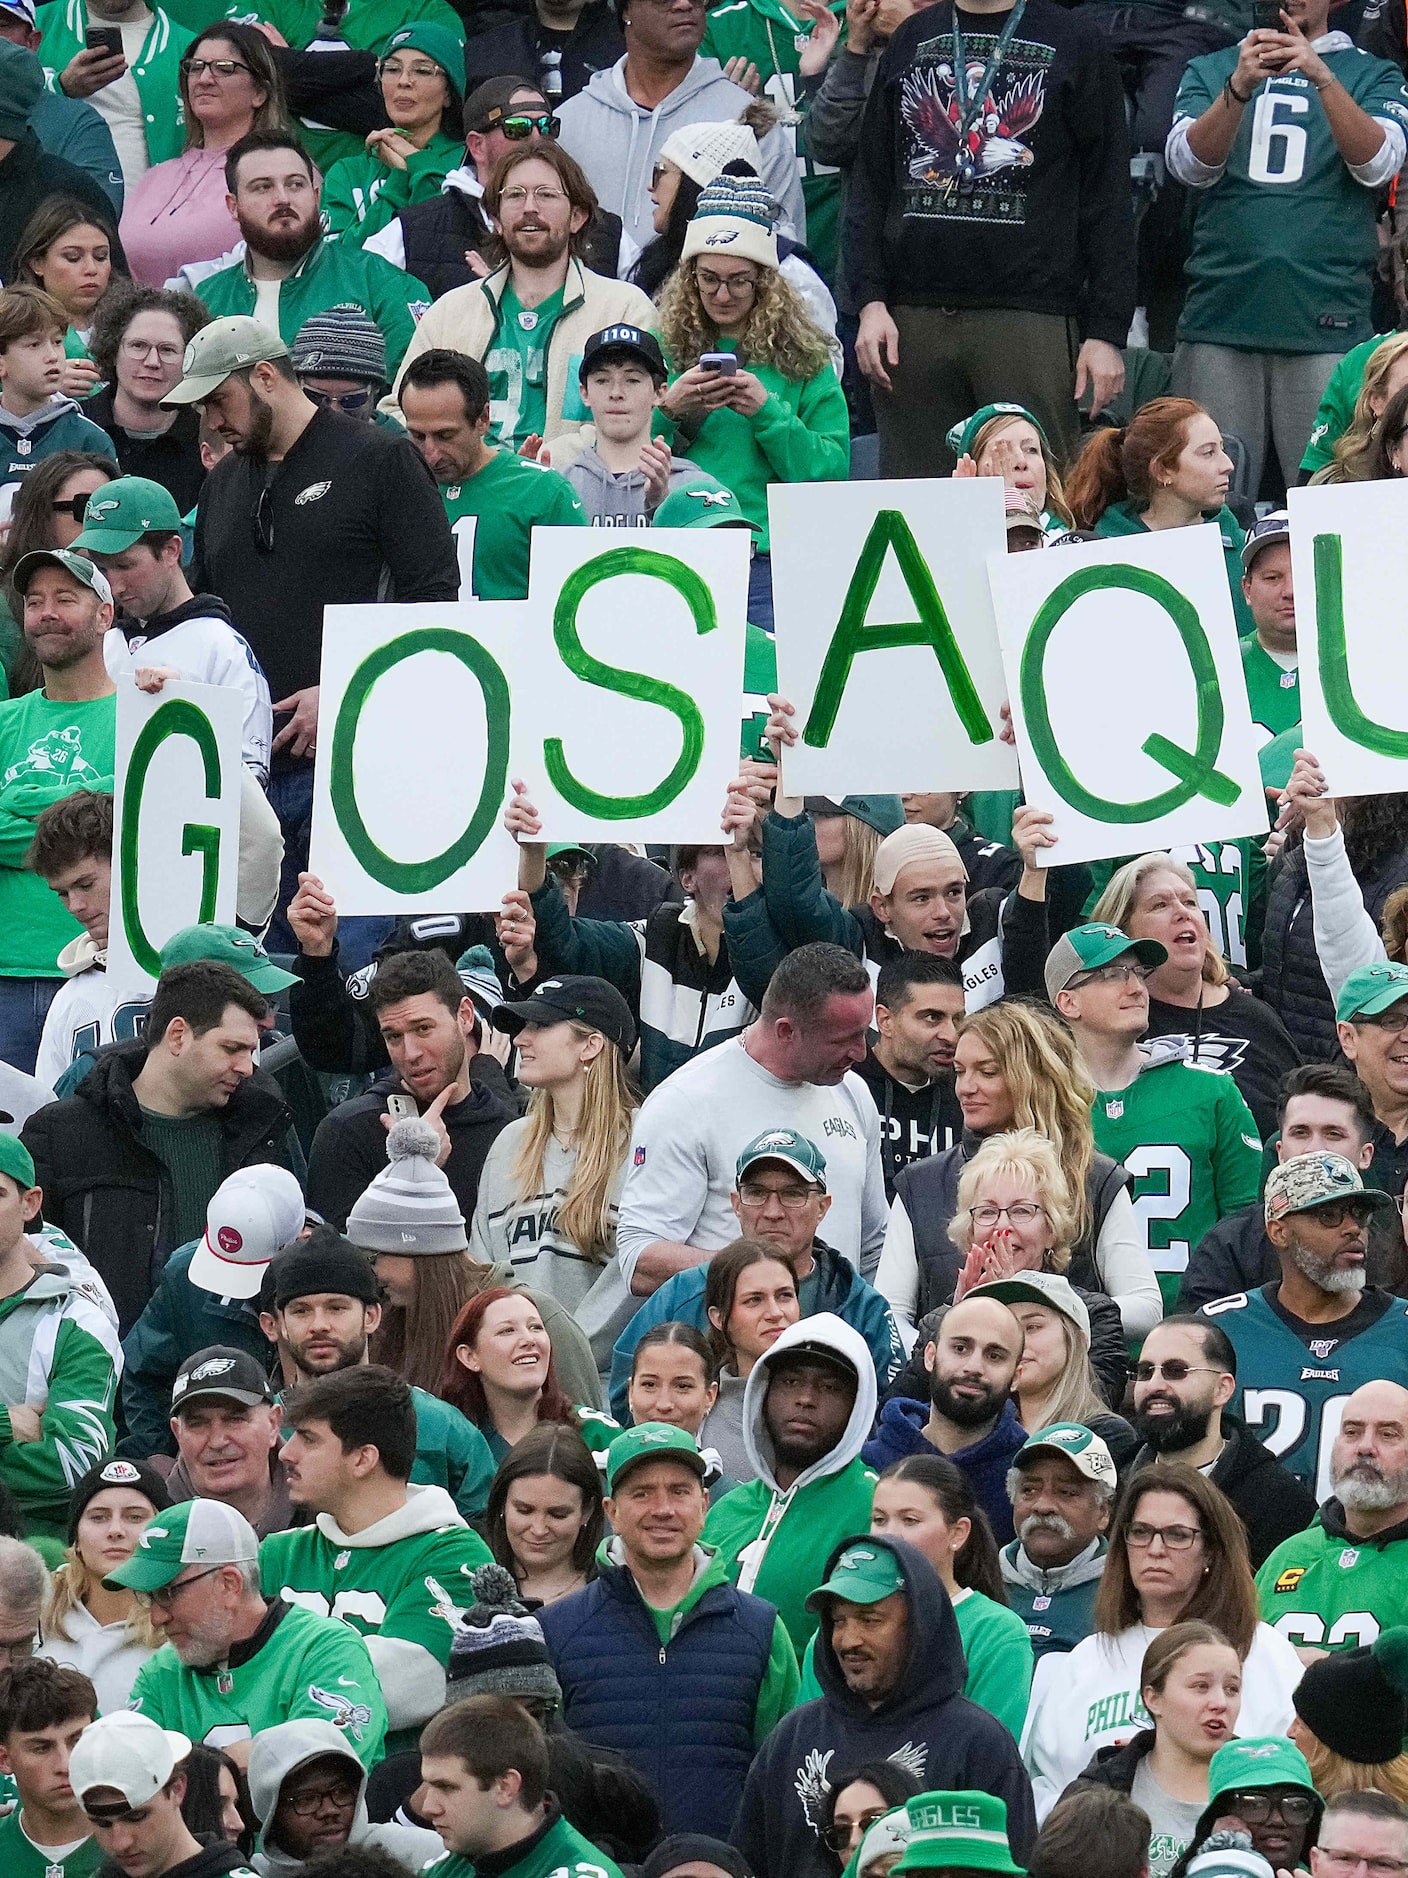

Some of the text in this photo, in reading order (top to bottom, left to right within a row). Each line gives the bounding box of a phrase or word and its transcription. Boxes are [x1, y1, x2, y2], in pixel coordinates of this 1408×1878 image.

[1247, 92, 1309, 183] 6
[544, 546, 716, 820] S
[803, 509, 994, 748] A
[1020, 563, 1242, 824] Q
[121, 699, 221, 978] G
[331, 628, 510, 894] O
[1123, 1145, 1192, 1273] 2
[1302, 1366, 1340, 1382] EAGLES
